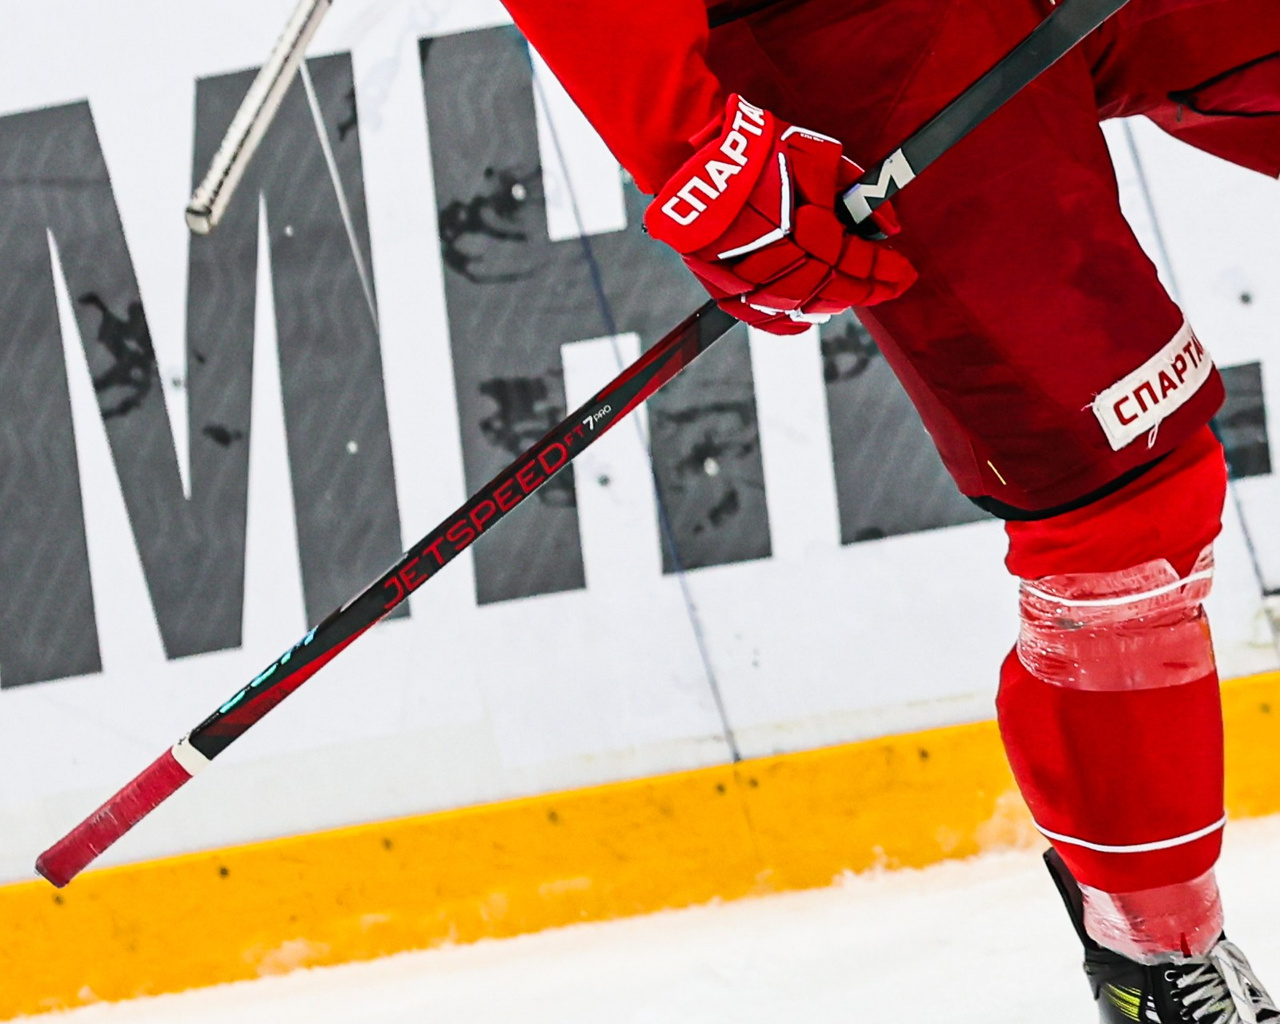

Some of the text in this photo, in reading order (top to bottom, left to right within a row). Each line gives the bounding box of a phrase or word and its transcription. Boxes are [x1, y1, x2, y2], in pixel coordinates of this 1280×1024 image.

[660, 94, 765, 226] СПАРТА
[1112, 335, 1205, 427] СПАРТА
[383, 441, 569, 611] JETSPEED
